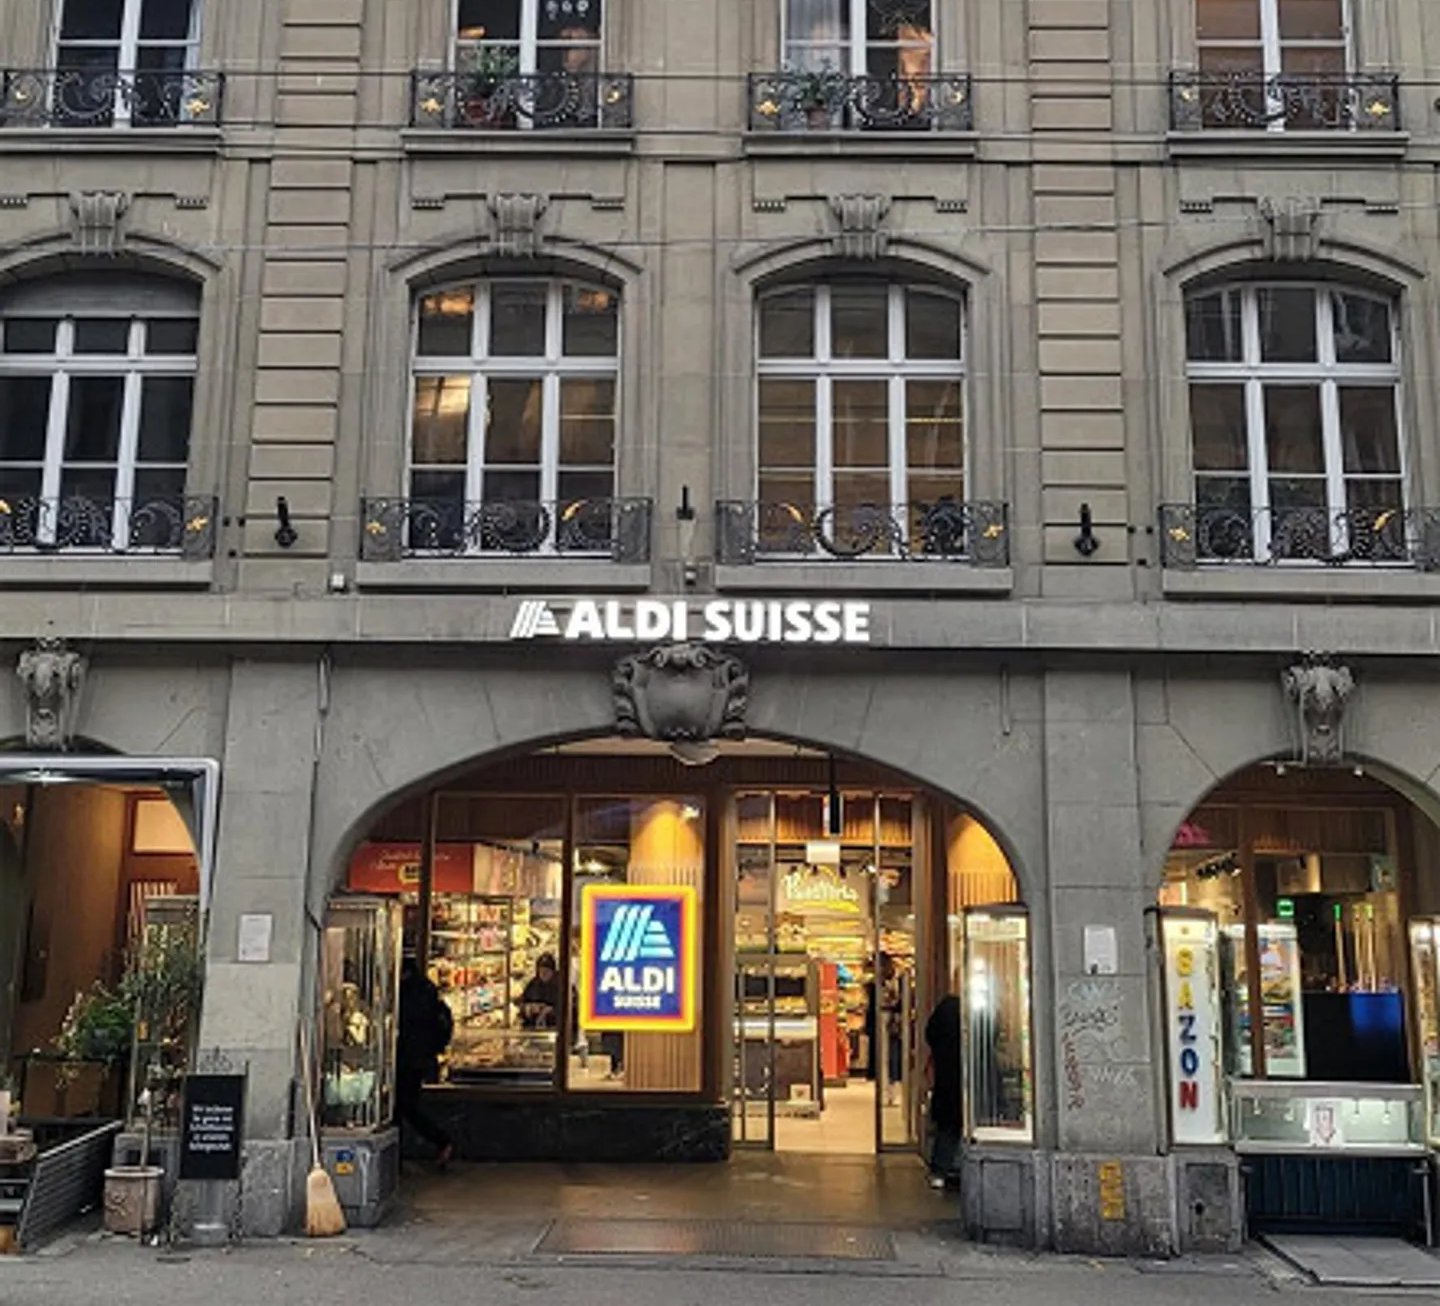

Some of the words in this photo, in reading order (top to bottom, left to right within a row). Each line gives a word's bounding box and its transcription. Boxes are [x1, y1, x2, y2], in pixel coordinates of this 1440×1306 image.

[564, 599, 688, 640] ALDI
[703, 600, 871, 642] SUISSE
[599, 966, 675, 994] ALDI
[612, 995, 662, 1009] SUISSE
[1175, 946, 1199, 1111] SAZON
